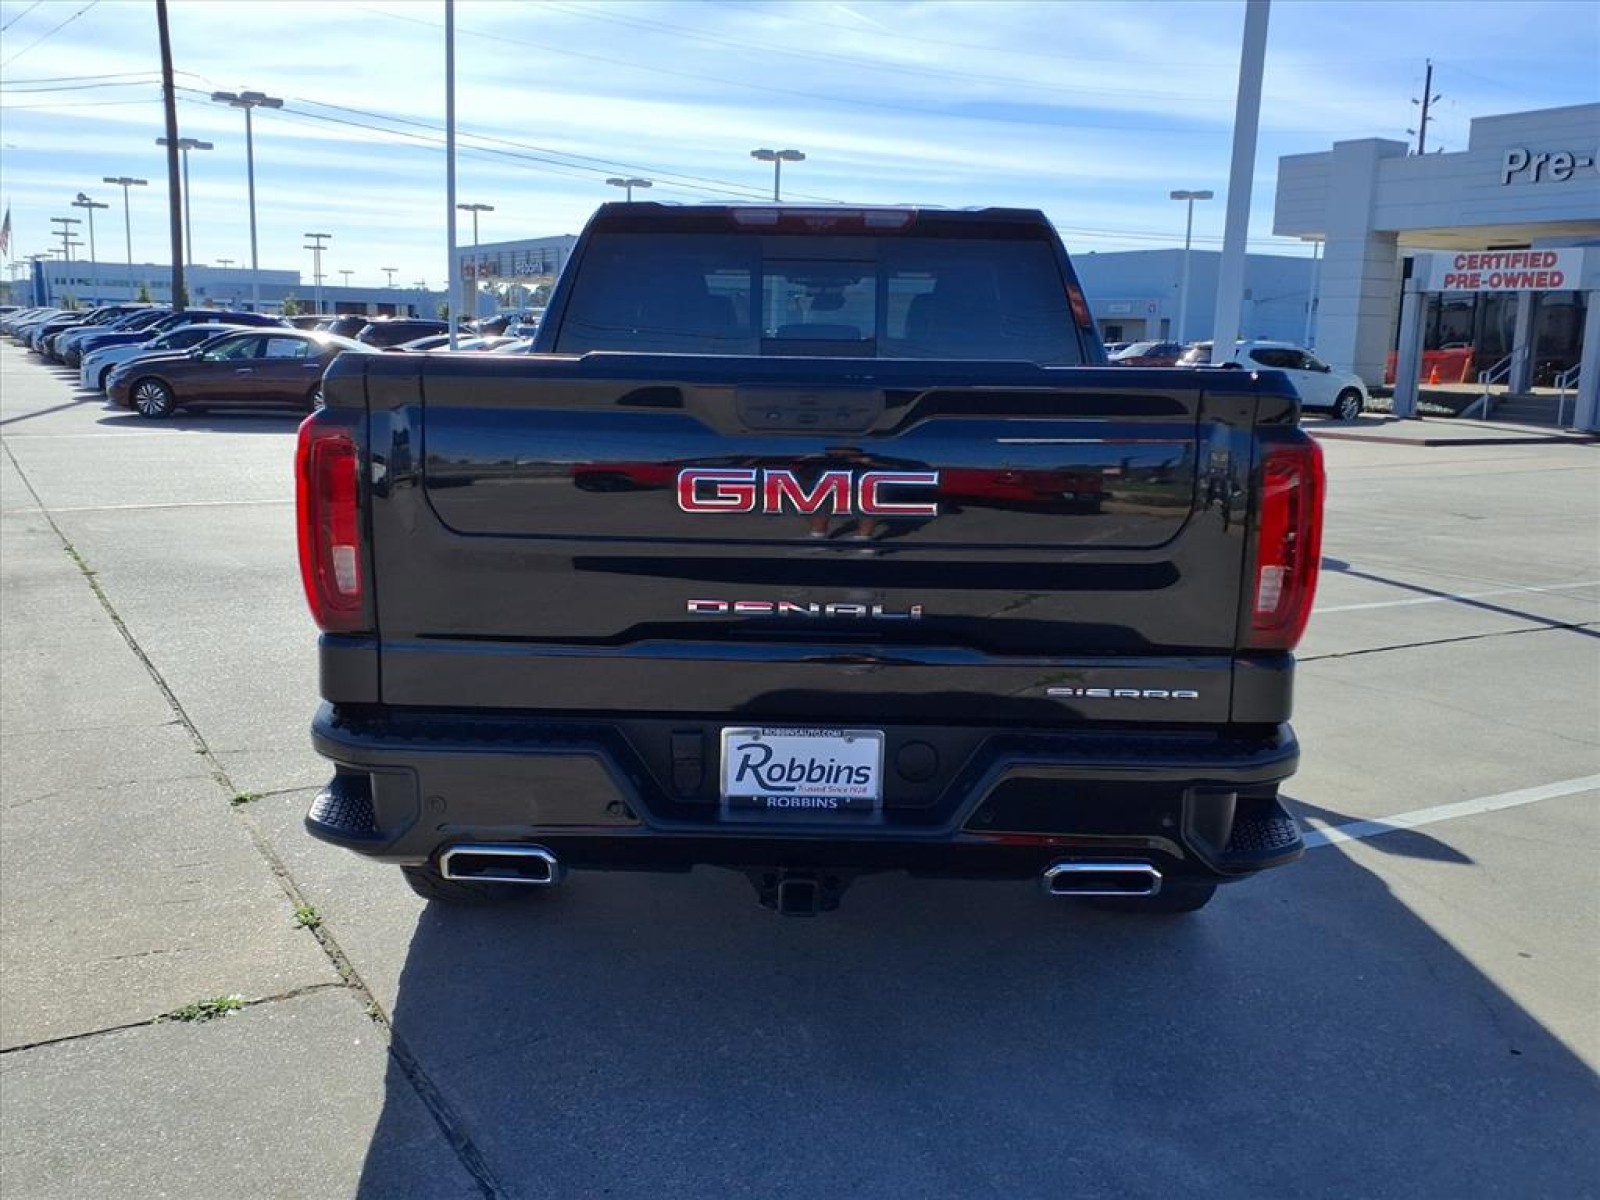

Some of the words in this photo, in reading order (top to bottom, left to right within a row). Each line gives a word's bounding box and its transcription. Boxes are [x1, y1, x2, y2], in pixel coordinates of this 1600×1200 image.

[1454, 251, 1558, 271] CERTIFIED
[1443, 270, 1565, 289] PRE-OWNED
[677, 468, 939, 517] GMC
[686, 599, 922, 620] DENALI
[1046, 688, 1199, 699] SIERRA
[735, 743, 871, 792] Robbins
[828, 785, 848, 794] Since
[766, 796, 839, 809] ROBBINS
